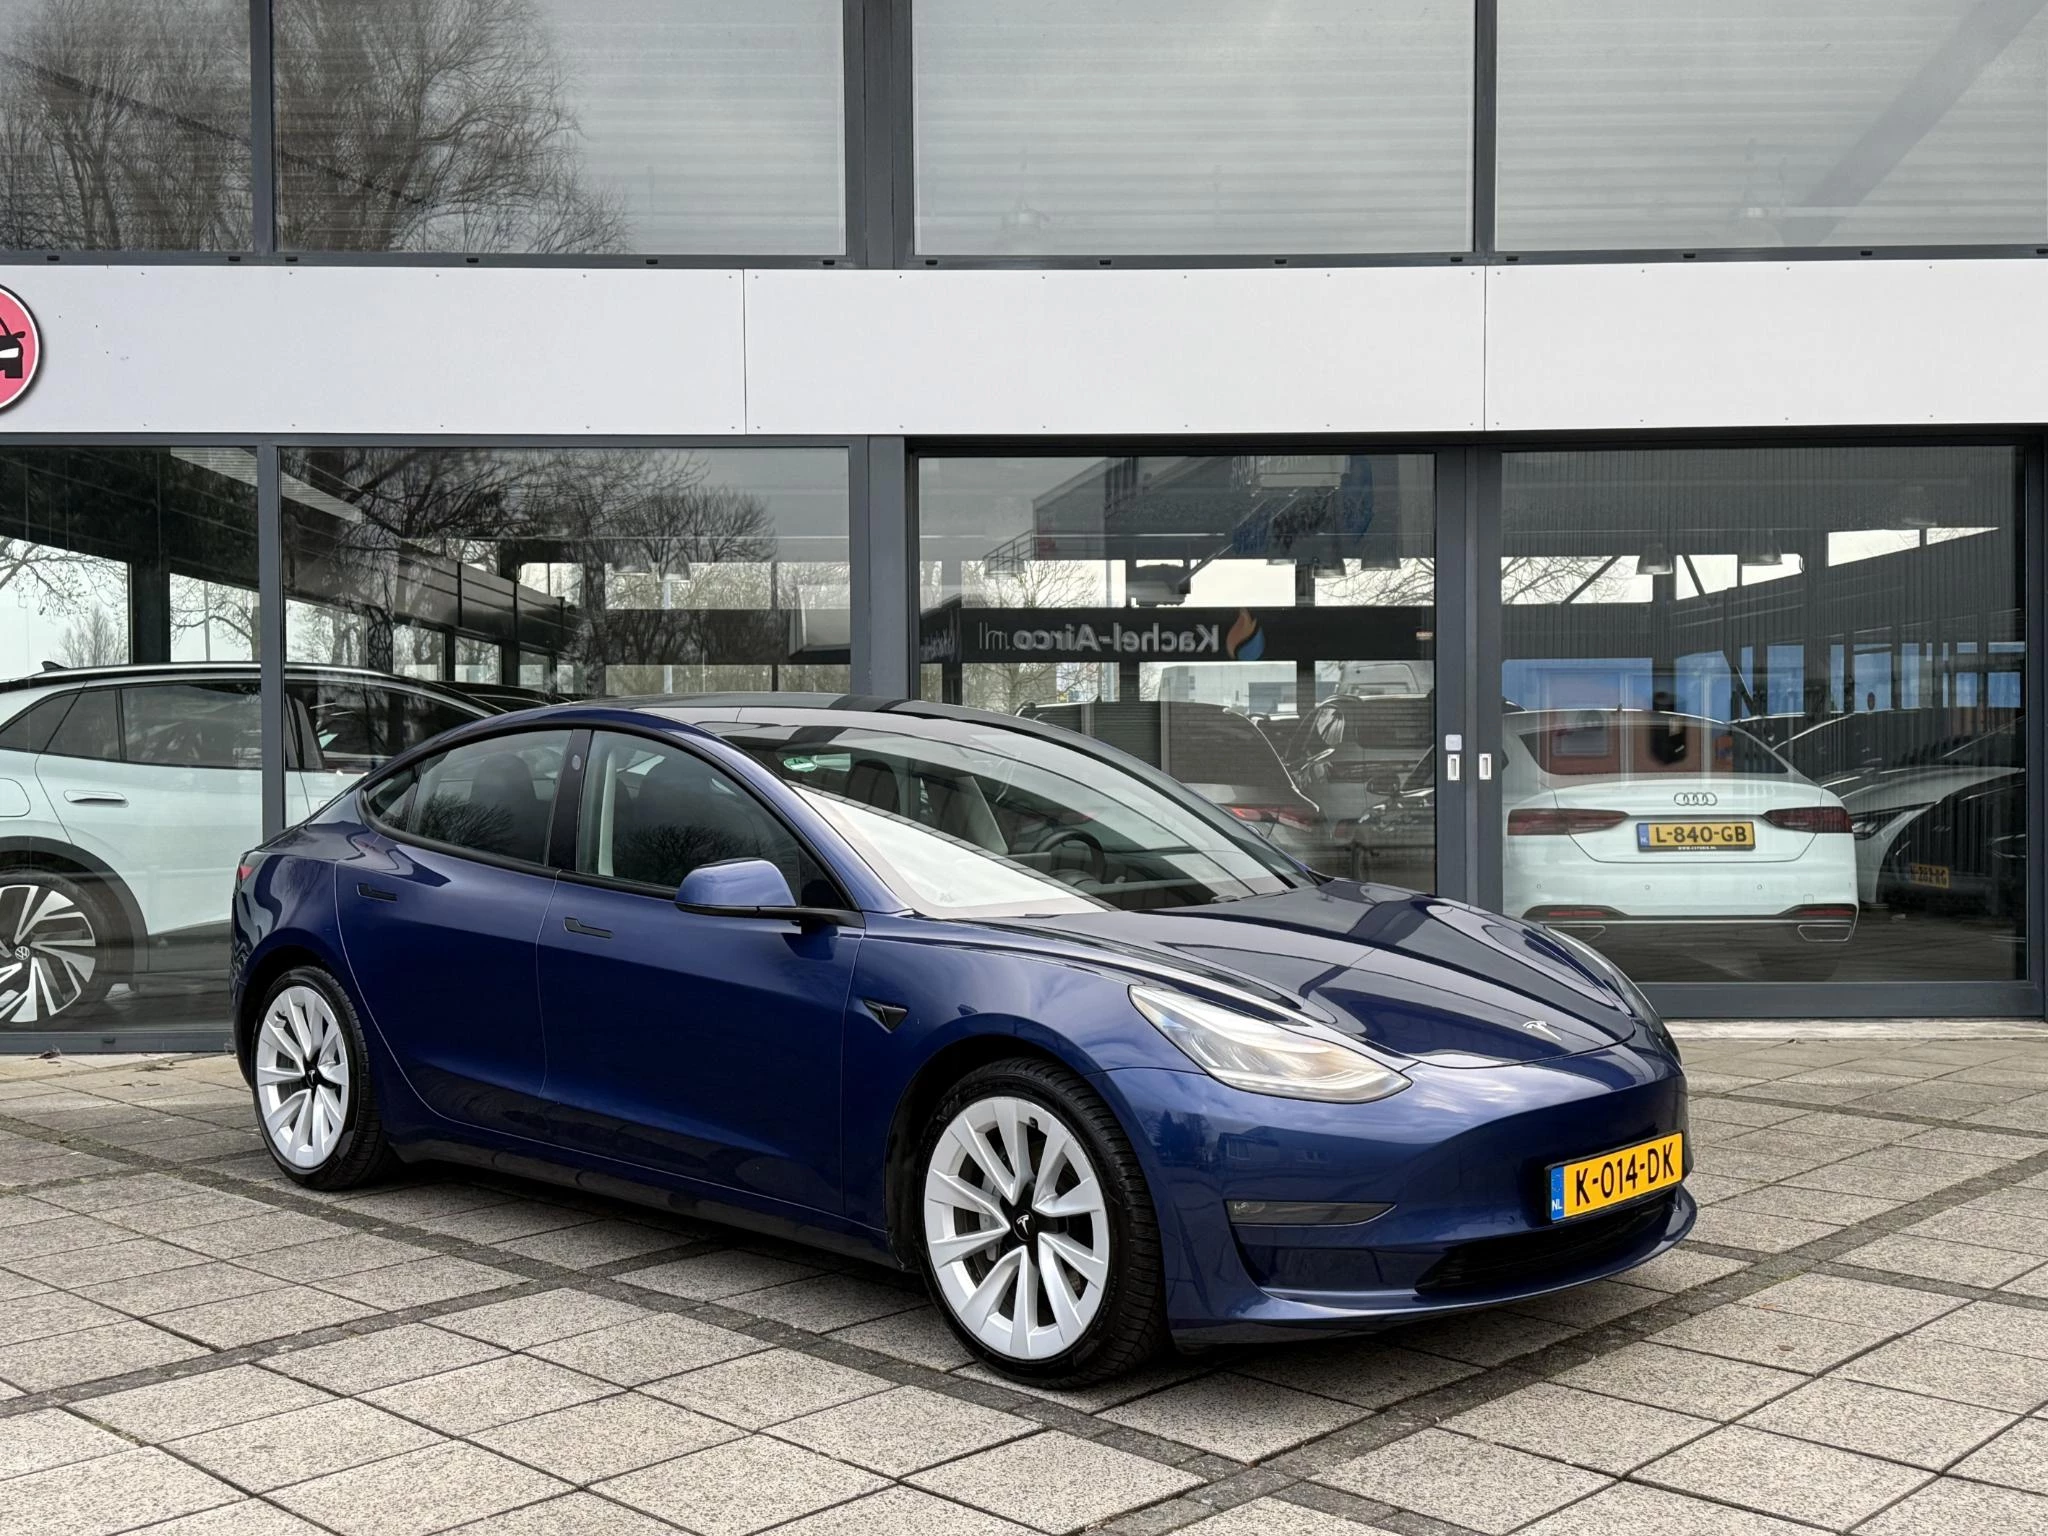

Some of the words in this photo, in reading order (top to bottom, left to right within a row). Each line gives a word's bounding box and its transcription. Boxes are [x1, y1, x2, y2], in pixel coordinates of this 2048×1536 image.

[1655, 826, 1747, 843] L-840-GB
[1551, 1198, 1563, 1212] NL
[1576, 1142, 1675, 1207] K-014-DK
